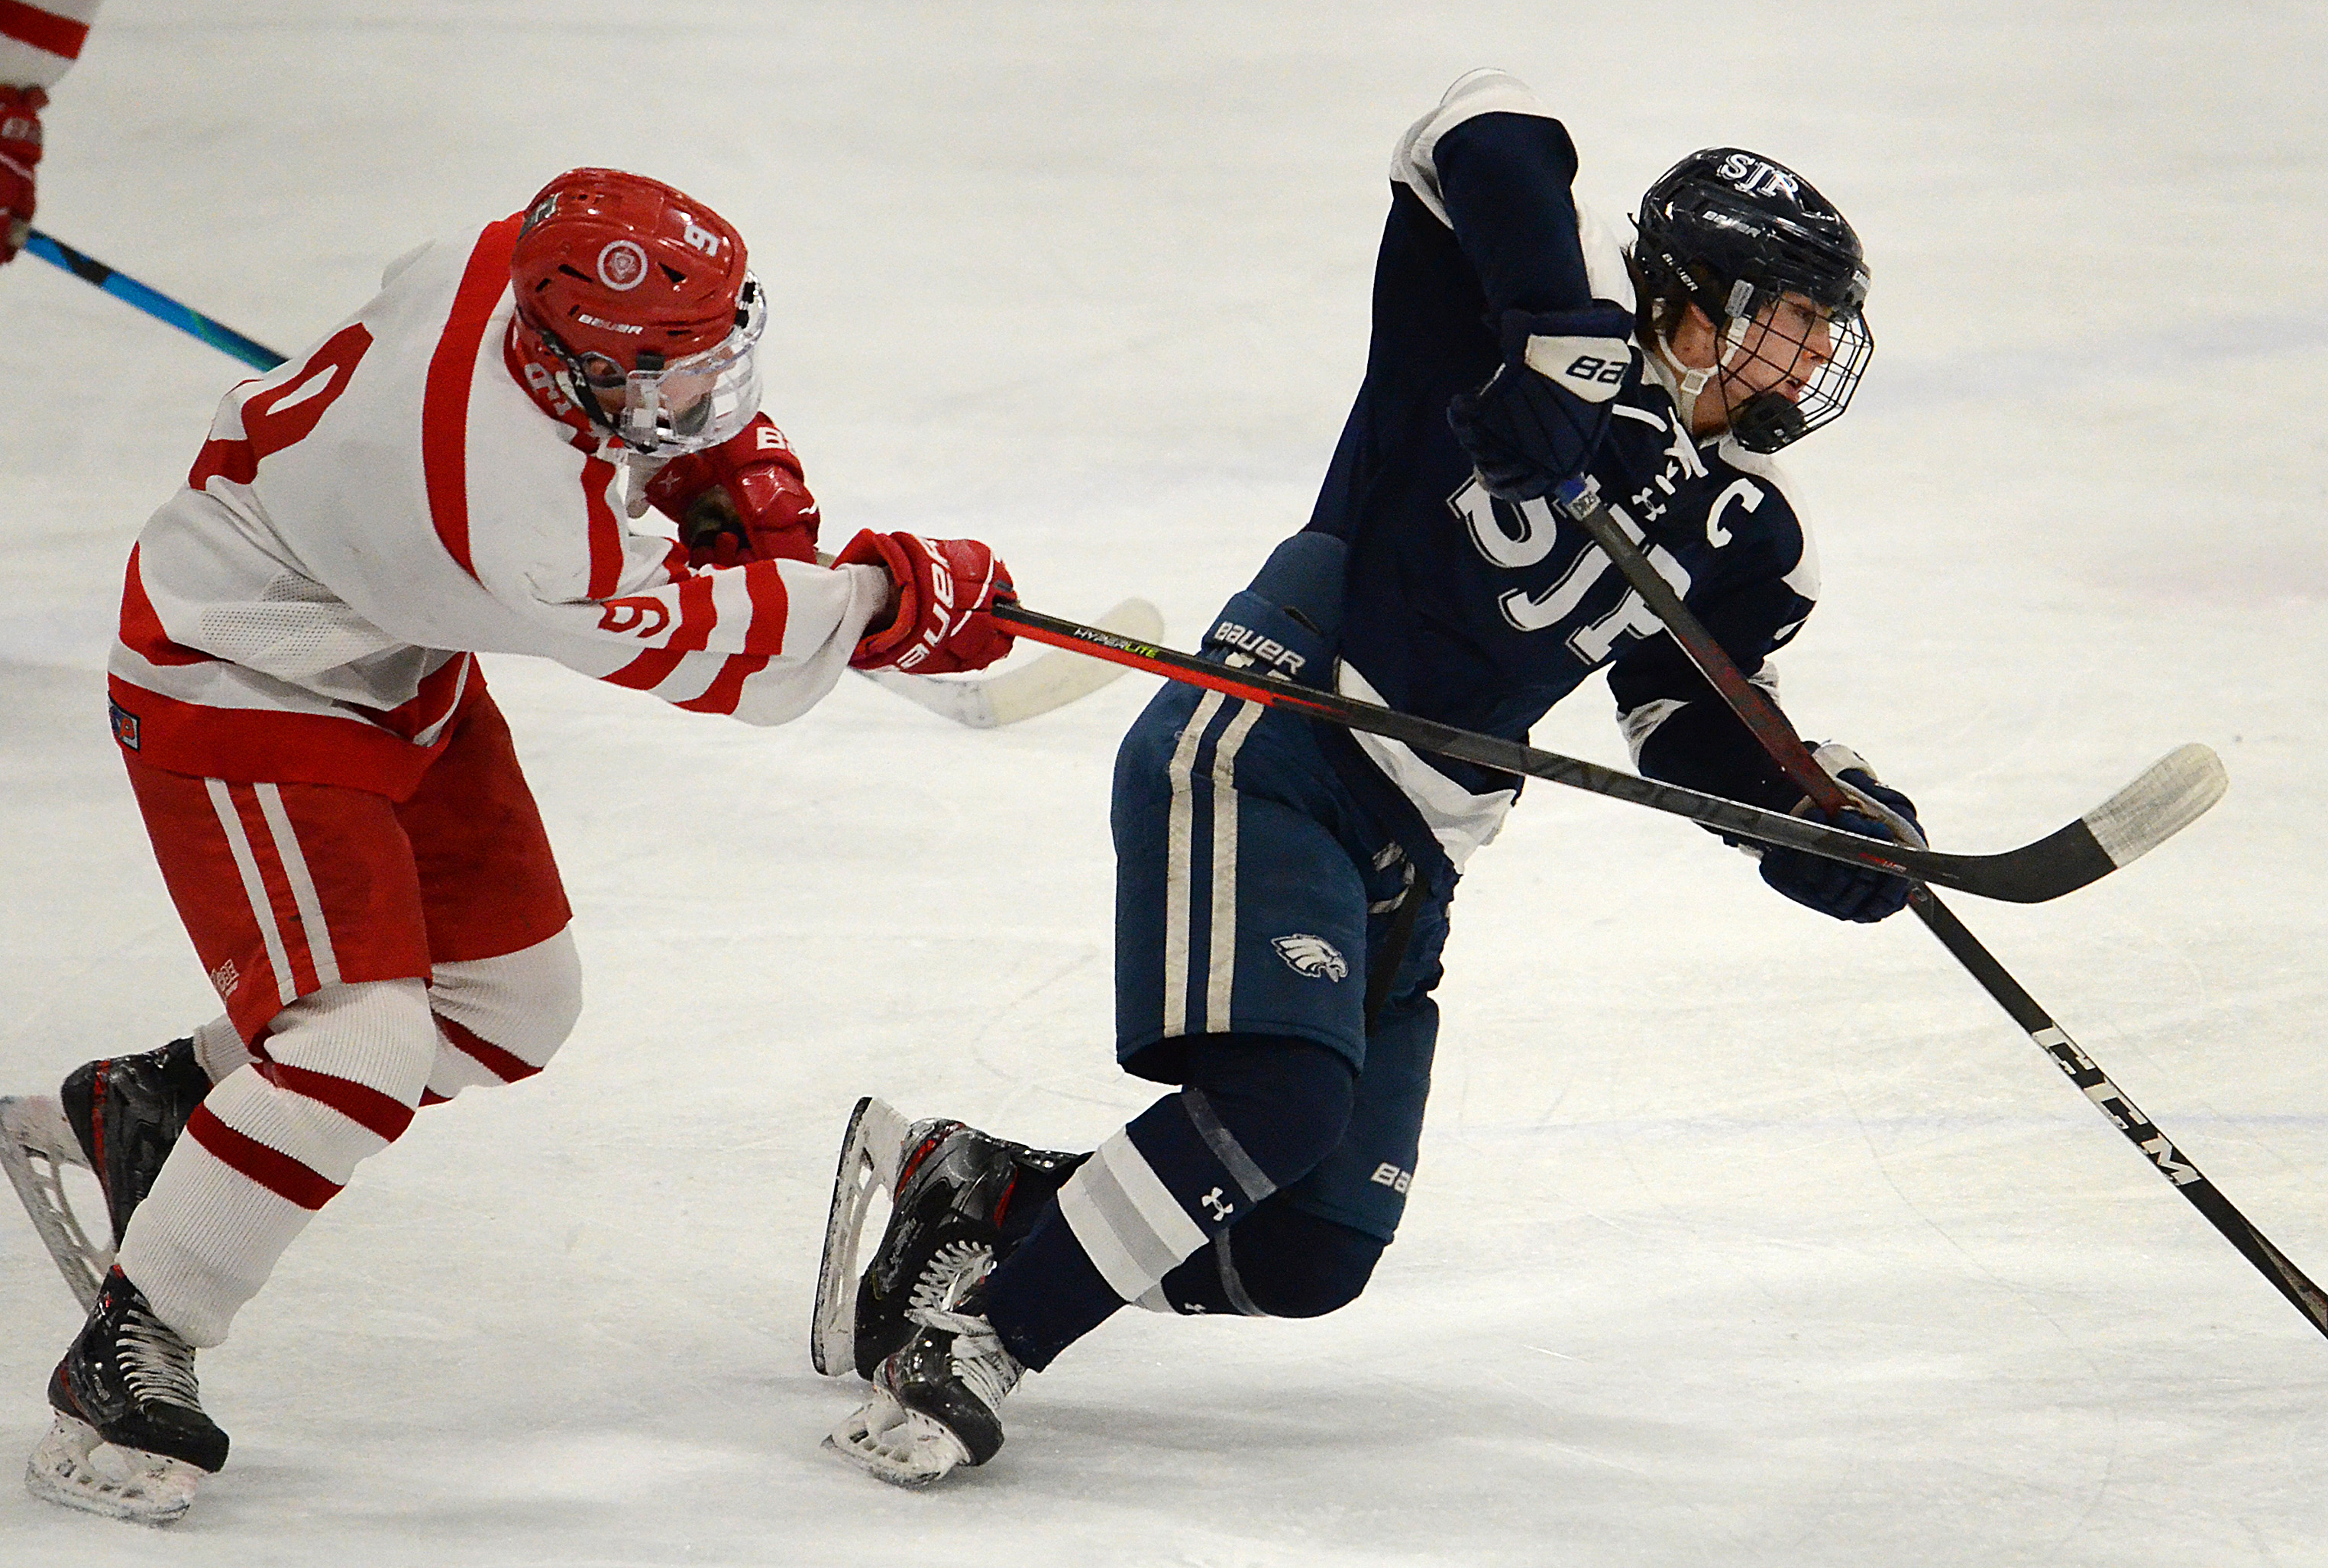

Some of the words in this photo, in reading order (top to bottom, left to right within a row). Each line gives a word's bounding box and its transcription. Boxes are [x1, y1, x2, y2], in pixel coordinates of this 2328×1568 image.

[1716, 154, 1799, 198] SJP
[684, 225, 719, 257] 9
[1706, 478, 1764, 548] C
[598, 596, 670, 638] 9
[1074, 627, 1159, 658] HYPERLITE
[1214, 620, 1306, 674] BAUER
[2031, 1020, 2203, 1186] CCM
